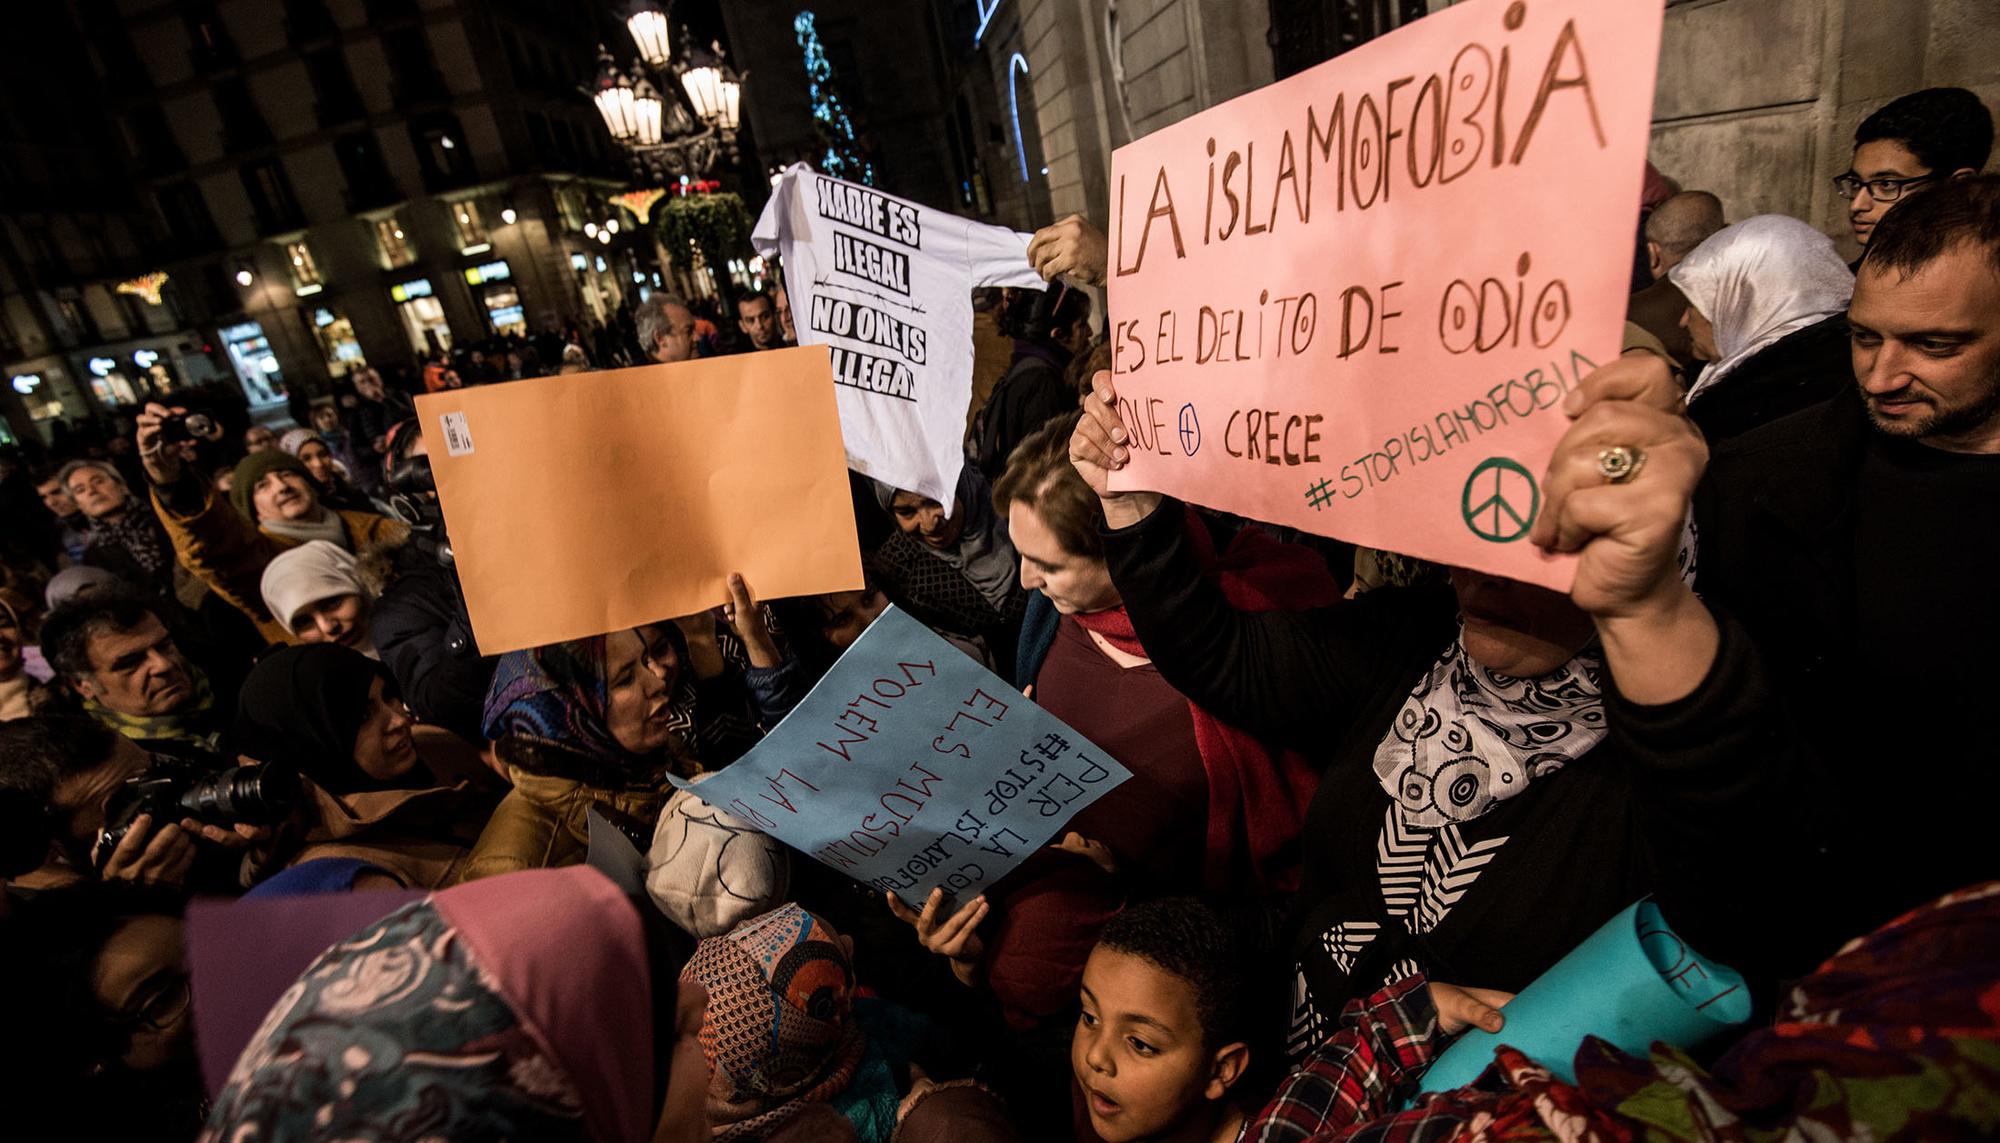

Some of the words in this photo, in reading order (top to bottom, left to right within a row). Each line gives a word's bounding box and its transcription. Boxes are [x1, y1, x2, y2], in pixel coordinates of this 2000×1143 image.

[817, 177, 885, 236] NADIE
[886, 199, 920, 249] ES
[1116, 165, 1186, 277] LA
[834, 232, 910, 296] ILEGAL
[812, 295, 852, 336] NO
[856, 305, 902, 352] ONE
[901, 322, 926, 365] IS
[1113, 320, 1146, 375] ES
[1155, 310, 1184, 365] EL
[1336, 281, 1404, 361] DE
[828, 345, 917, 402] LLEGA
[1118, 396, 1172, 456] QUE
[1224, 408, 1325, 467] CRECE
[816, 659, 936, 762] VOLEM
[931, 687, 1010, 761] ELS
[758, 767, 820, 815] LA
[1028, 752, 1110, 817] PER
[980, 826, 1030, 860] LA
